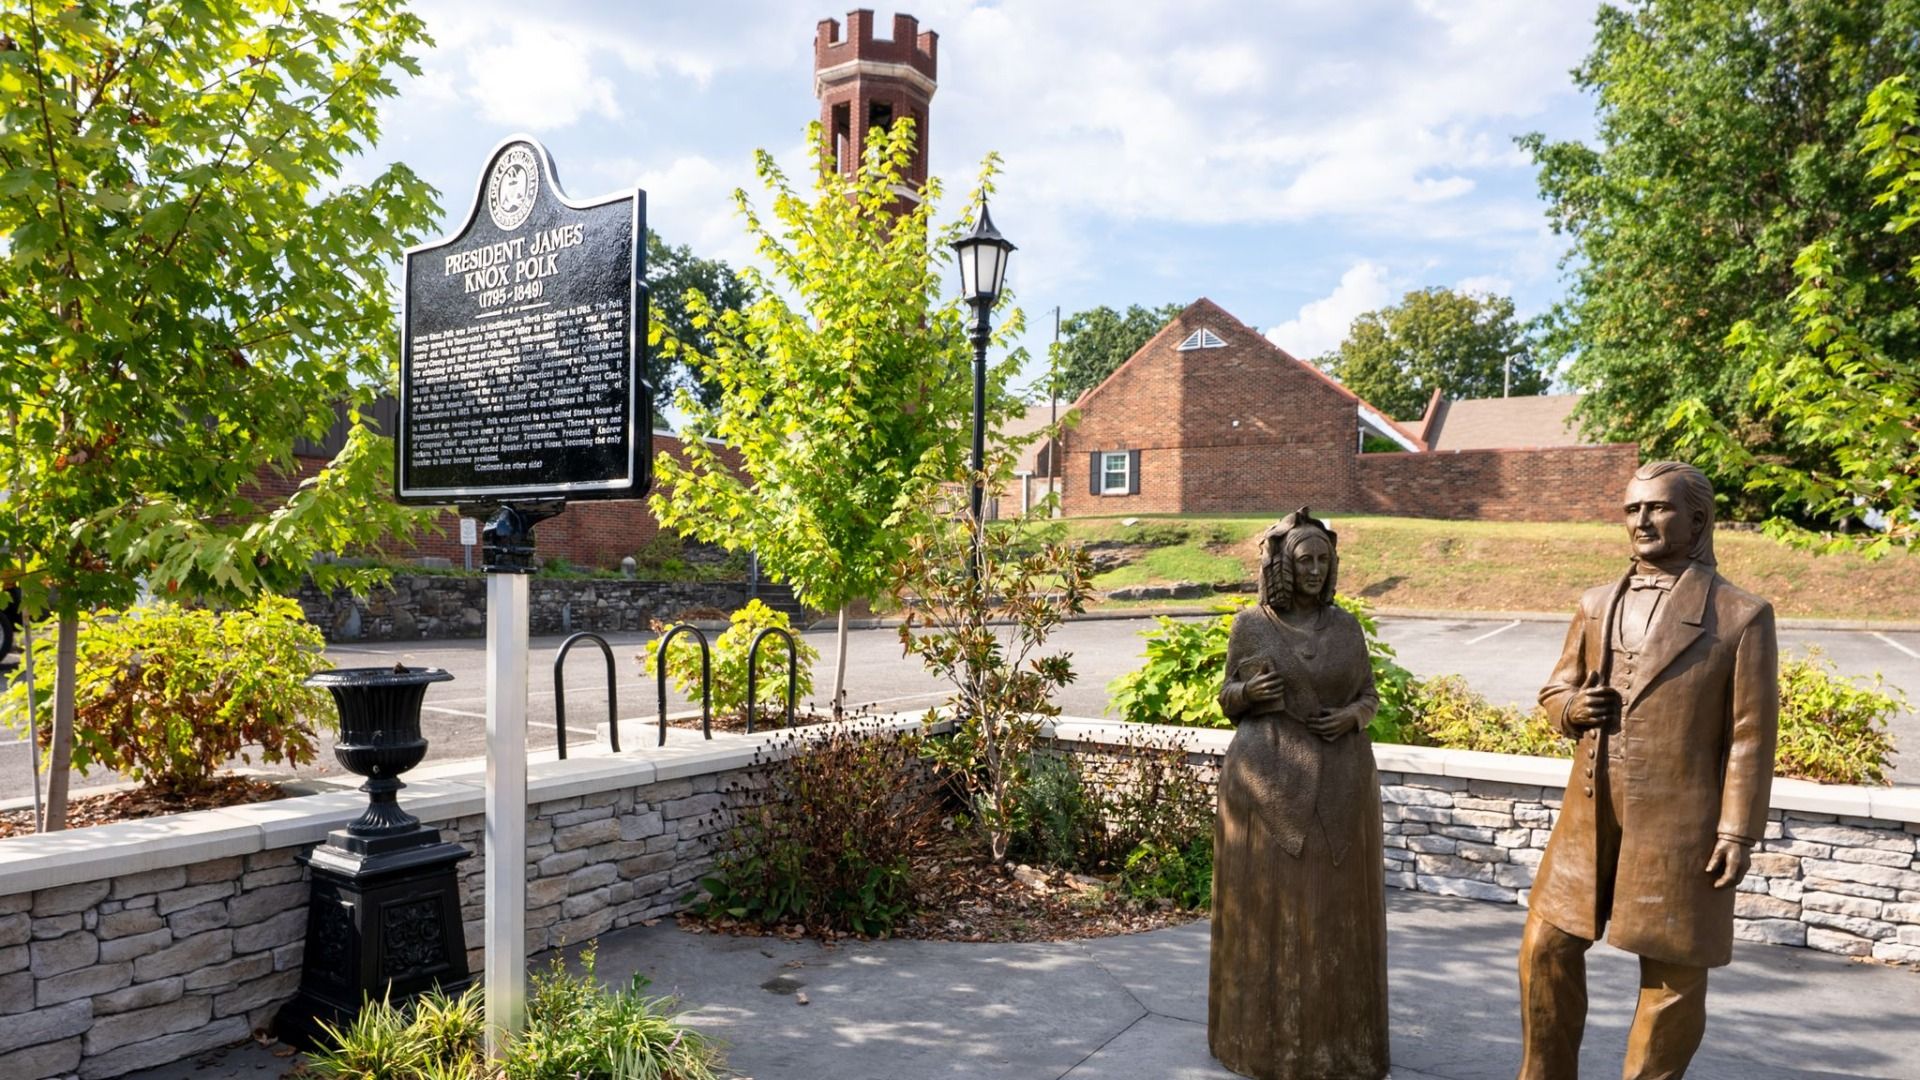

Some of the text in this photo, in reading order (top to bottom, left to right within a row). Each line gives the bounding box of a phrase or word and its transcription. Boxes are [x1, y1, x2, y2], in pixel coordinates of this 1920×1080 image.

[445, 224, 584, 276] PRESIDENT JAMES
[465, 253, 558, 293] KNOX POLK
[479, 280, 544, 308] (1795-1849)
[523, 314, 540, 324] North
[542, 309, 567, 321] Carolina
[595, 302, 606, 312] The
[609, 299, 622, 309] Polk
[585, 315, 596, 323] was
[601, 310, 622, 321] eleven
[568, 327, 578, 336] the
[583, 322, 608, 334] creation
[603, 330, 622, 342] began
[581, 342, 608, 354] Columbia
[611, 340, 622, 349] and
[572, 356, 586, 365] with
[589, 354, 599, 364] top
[602, 351, 622, 361] honors
[526, 370, 553, 382] practiced
[557, 368, 567, 377] law
[542, 379, 554, 388] first
[565, 376, 575, 385] the
[578, 374, 601, 384] elected
[604, 371, 621, 381] Clerk
[539, 389, 548, 398] the
[553, 386, 582, 396] Tennessee
[589, 383, 607, 393] House
[505, 401, 527, 410] married
[530, 399, 546, 408] Sarah
[548, 396, 575, 406] Childress
[510, 414, 530, 422] elected
[552, 410, 571, 419] United
[573, 408, 591, 417] States
[594, 406, 612, 415] House
[521, 422, 545, 431] fourteen
[567, 419, 584, 427] There
[562, 428, 590, 437] President
[597, 426, 621, 435] Andrew
[500, 443, 522, 452] Speaker
[564, 438, 593, 448] becoming
[606, 436, 621, 446] only
